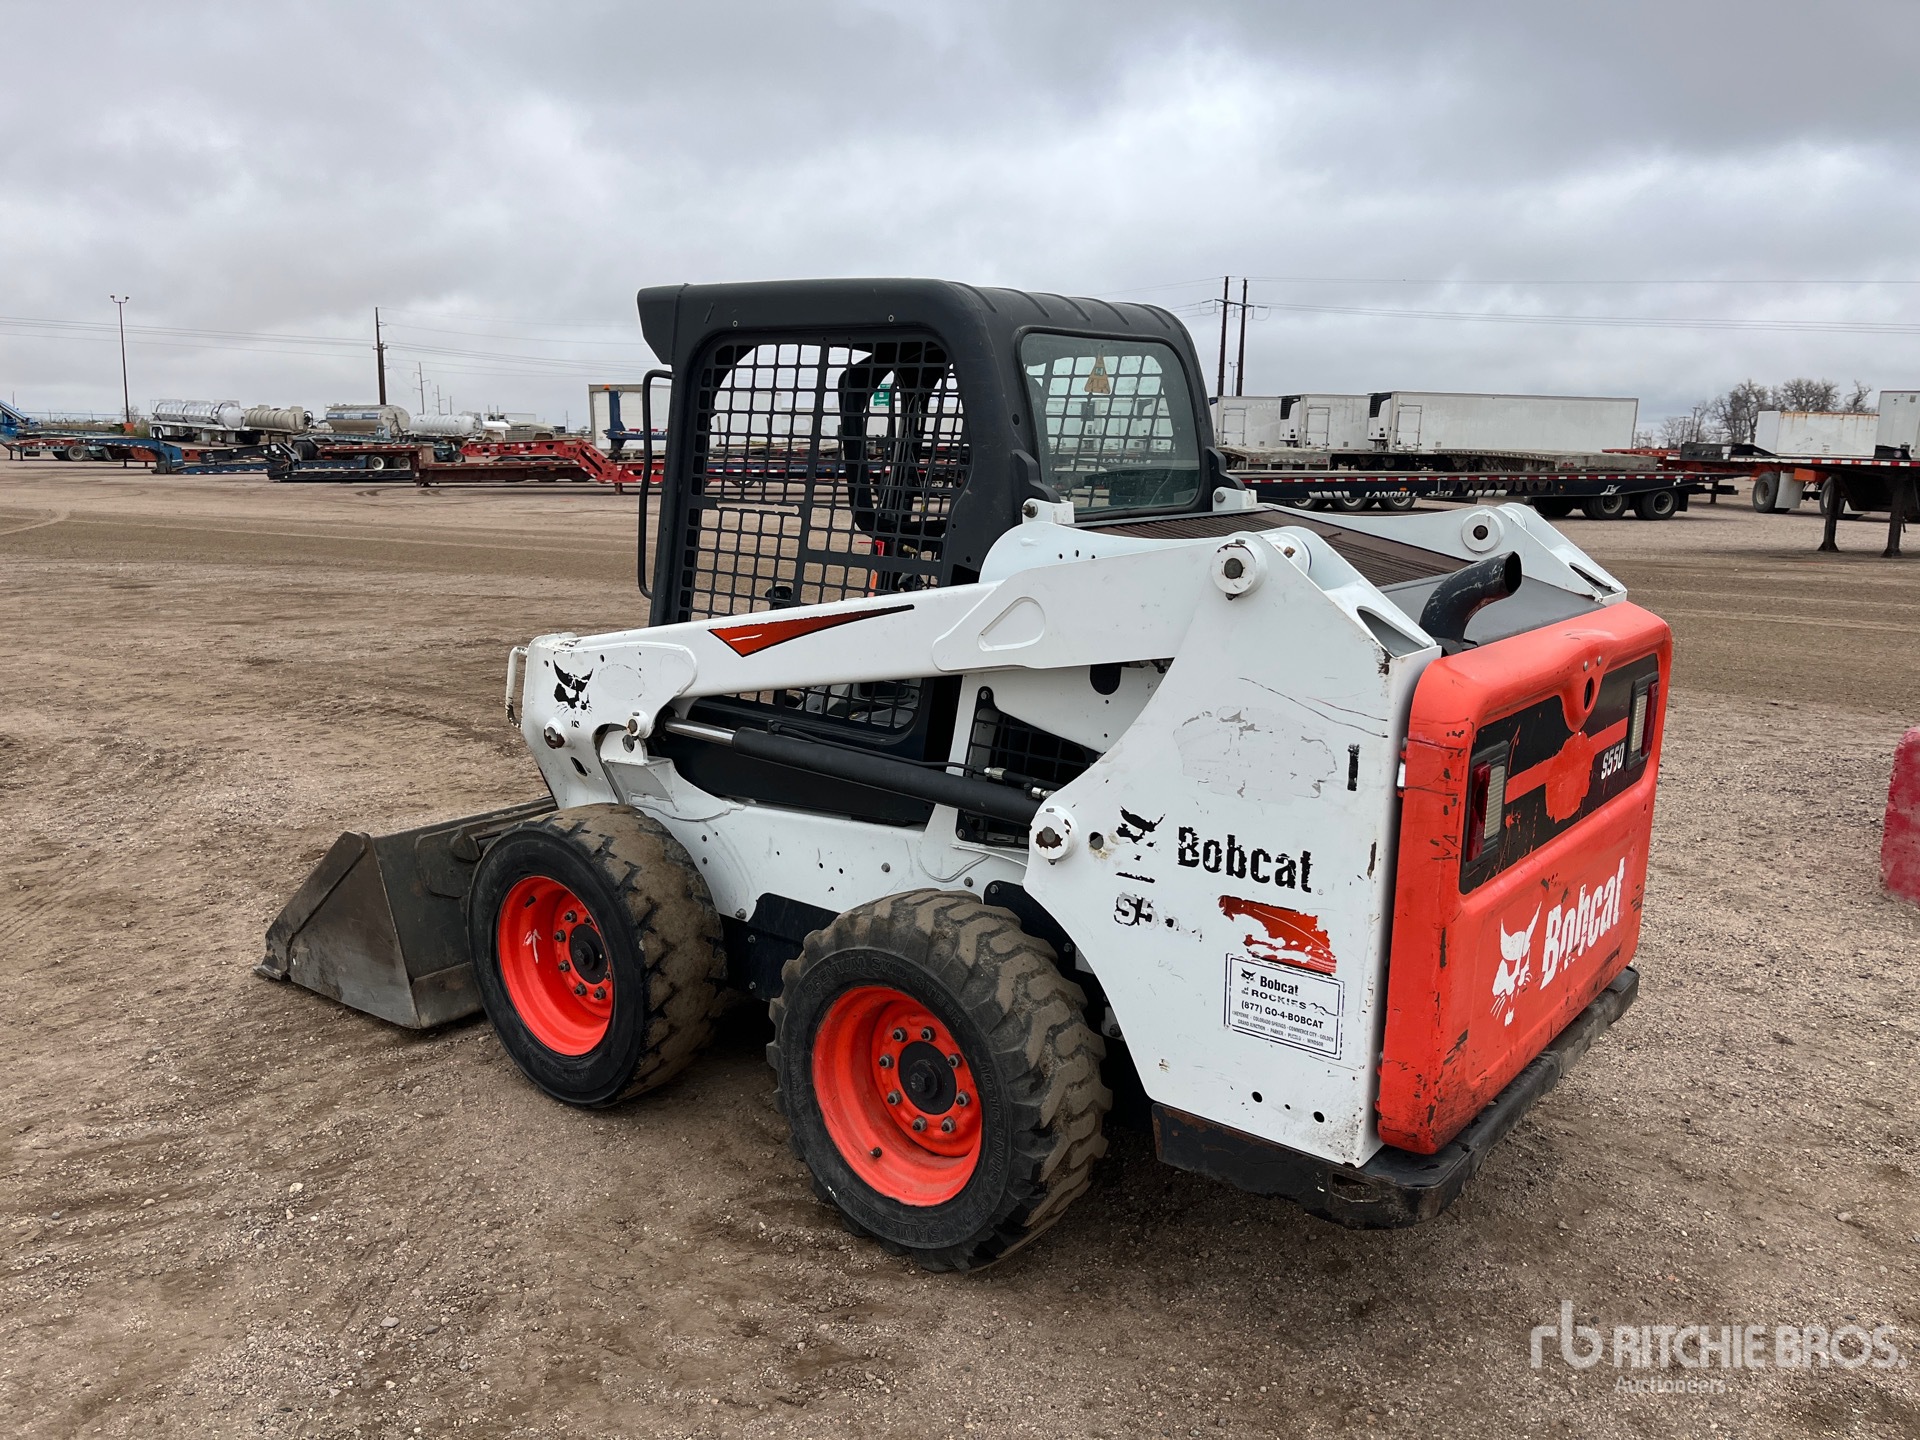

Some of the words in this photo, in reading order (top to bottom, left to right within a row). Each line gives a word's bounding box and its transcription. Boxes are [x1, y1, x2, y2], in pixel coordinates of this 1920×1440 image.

[1601, 742, 1625, 780] S550
[1178, 826, 1313, 893] Bobcat
[1540, 857, 1625, 990] Bobcat
[1260, 976, 1299, 996] Bobcat
[1241, 1000, 1263, 1014] (877)
[1265, 1006, 1324, 1029] GO-4-BOBCAT
